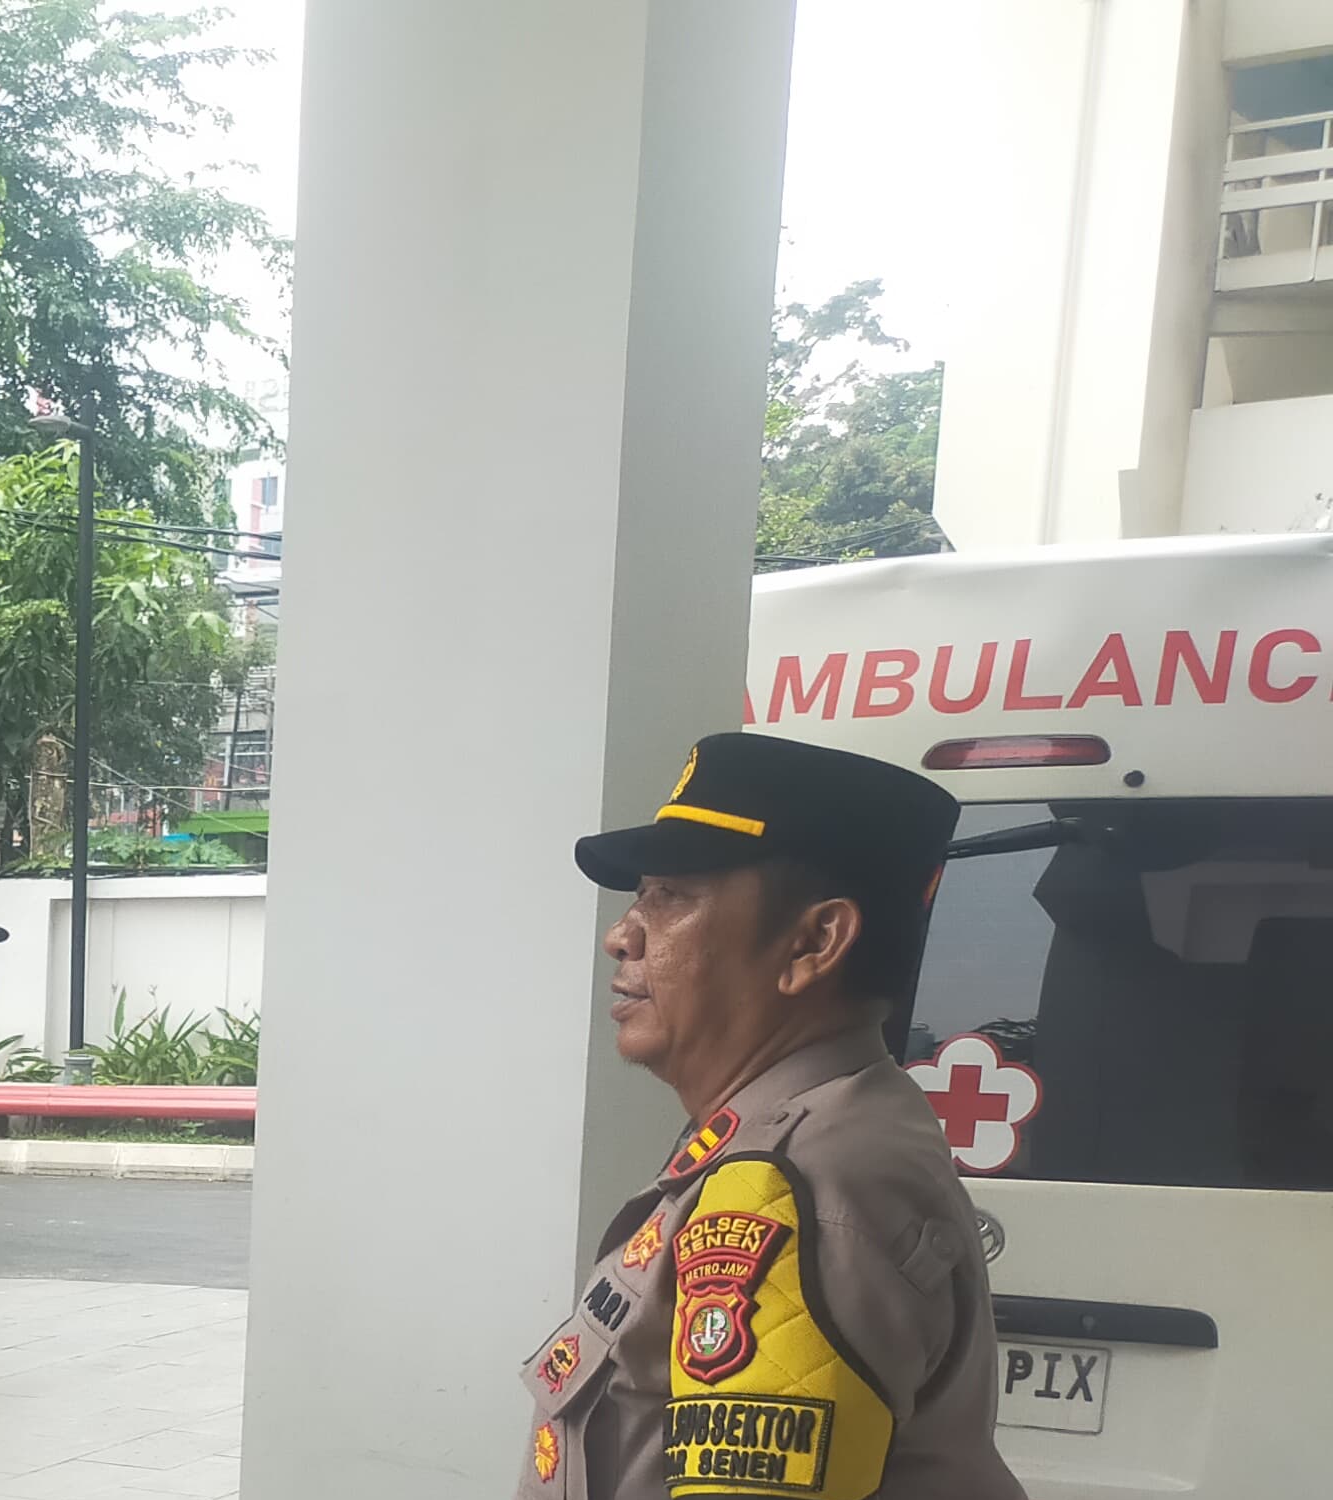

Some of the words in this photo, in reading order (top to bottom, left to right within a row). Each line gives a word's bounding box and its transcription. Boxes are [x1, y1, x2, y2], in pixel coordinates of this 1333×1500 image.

[742, 630, 1333, 724] MBULANC
[678, 1216, 767, 1248] POLSEK
[679, 1233, 761, 1261] SENEN
[685, 1262, 720, 1284] METRO
[721, 1262, 749, 1277] JAYA
[1004, 1348, 1098, 1403] PIX
[698, 1448, 788, 1482] SENEN
